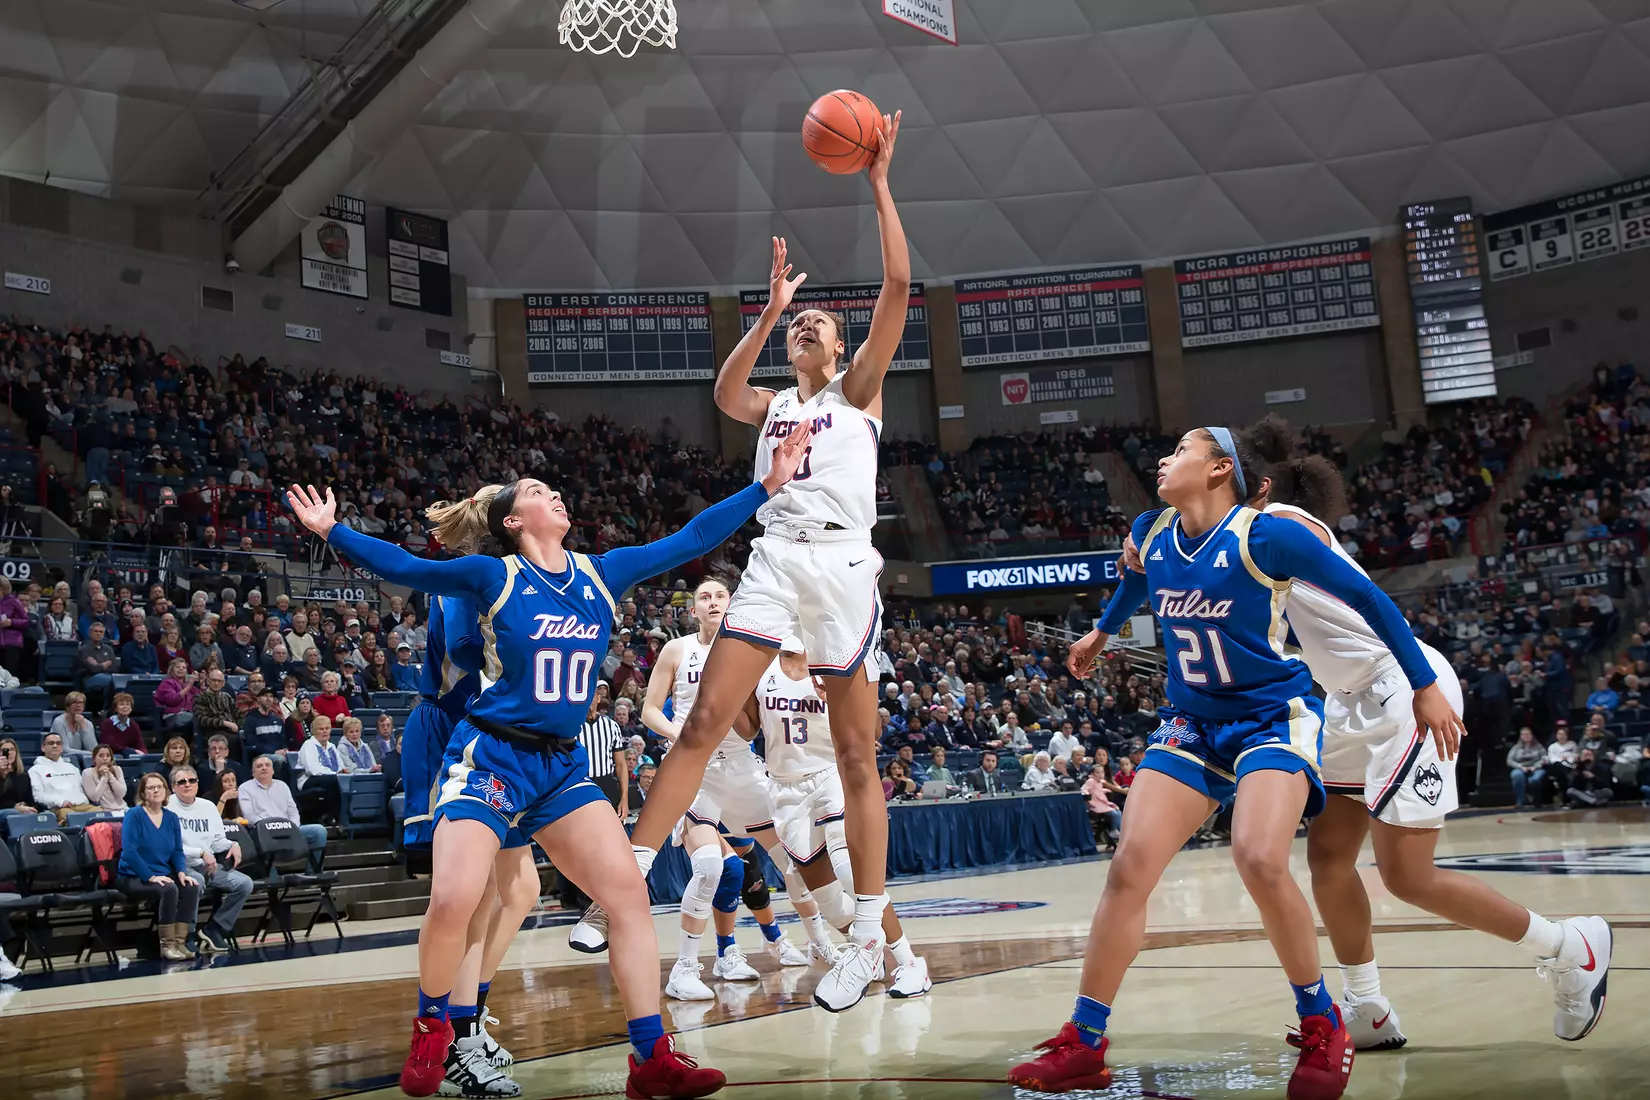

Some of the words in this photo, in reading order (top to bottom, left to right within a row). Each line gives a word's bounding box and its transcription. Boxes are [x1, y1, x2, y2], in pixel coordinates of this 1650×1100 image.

[907, 0, 944, 18] IONAL
[893, 2, 948, 36] CHAMPIONS
[1581, 227, 1612, 250] 22
[1185, 258, 1229, 271] NCAA
[1236, 240, 1359, 265] CHAMPIONSHIP
[1546, 239, 1558, 258] 9
[1499, 249, 1517, 269] C
[1186, 264, 1267, 281] TOURNAMENT
[1272, 253, 1363, 271] APPEARANCES
[6, 276, 21, 285] SEC
[26, 278, 49, 291] 210
[963, 279, 1010, 290] NATIONAL
[1013, 275, 1066, 287] INVITATION
[1069, 268, 1133, 281] TOURNAMENT
[793, 291, 830, 299] MERICAN
[832, 290, 869, 298] ATHLETIC
[1007, 283, 1092, 298] APPEARANCES
[528, 296, 553, 306] BIG
[561, 295, 600, 305] EAST
[607, 294, 706, 305] CONFERENCE
[758, 301, 836, 312] TNAMENT
[528, 308, 582, 316] REGULAR
[587, 307, 633, 316] SEASON
[639, 307, 706, 315] CHAMPIONS
[850, 310, 871, 323] 2002
[906, 308, 923, 320] 011
[961, 303, 981, 317] 1955
[988, 301, 1008, 314] 1974
[1014, 299, 1034, 313] 1975
[556, 319, 576, 332] 1994
[583, 318, 602, 331] 1995
[609, 318, 629, 331] 1996
[662, 318, 682, 330] 1999
[687, 317, 709, 330] 2002
[989, 319, 1010, 333] 1993
[1016, 317, 1035, 331] 1997
[1042, 315, 1063, 328] 2001
[1188, 330, 1261, 346] CONNECTICUT
[1303, 317, 1374, 332] BASKETBALL
[286, 326, 299, 335] SEC
[305, 328, 321, 340] 211
[529, 338, 551, 351] 2003
[556, 338, 578, 350] 2005
[583, 337, 604, 350] 2006
[441, 354, 452, 362] SEC
[455, 354, 471, 366] 212
[967, 352, 1038, 364] CONNECTICUT
[1078, 343, 1145, 355] BASKETBALL
[533, 373, 605, 381] CONNECTICUT
[609, 372, 641, 380] MEN'S
[644, 371, 711, 379] BASKETBALL
[751, 368, 790, 376] CONNEC
[1056, 368, 1087, 380] 1988
[1006, 384, 1025, 395] NIT
[1031, 380, 1066, 392] NATIONAL
[1070, 377, 1113, 388] INVITATION
[1032, 389, 1077, 402] TOURNAMENT
[1293, 390, 1301, 399] 6
[1066, 411, 1073, 421] 5
[772, 445, 812, 481] 0
[1583, 572, 1608, 586] 113
[313, 590, 331, 599] SEC
[334, 588, 365, 601] 109
[1155, 588, 1234, 618] Tulsa
[528, 613, 601, 641] Tulsa
[1171, 625, 1234, 686] 21
[534, 647, 595, 704] 00
[765, 696, 825, 714] UCONN
[781, 717, 808, 744] 13
[223, 824, 240, 833] ONN
[265, 821, 292, 830] UCONN
[29, 834, 62, 845] UCONN
